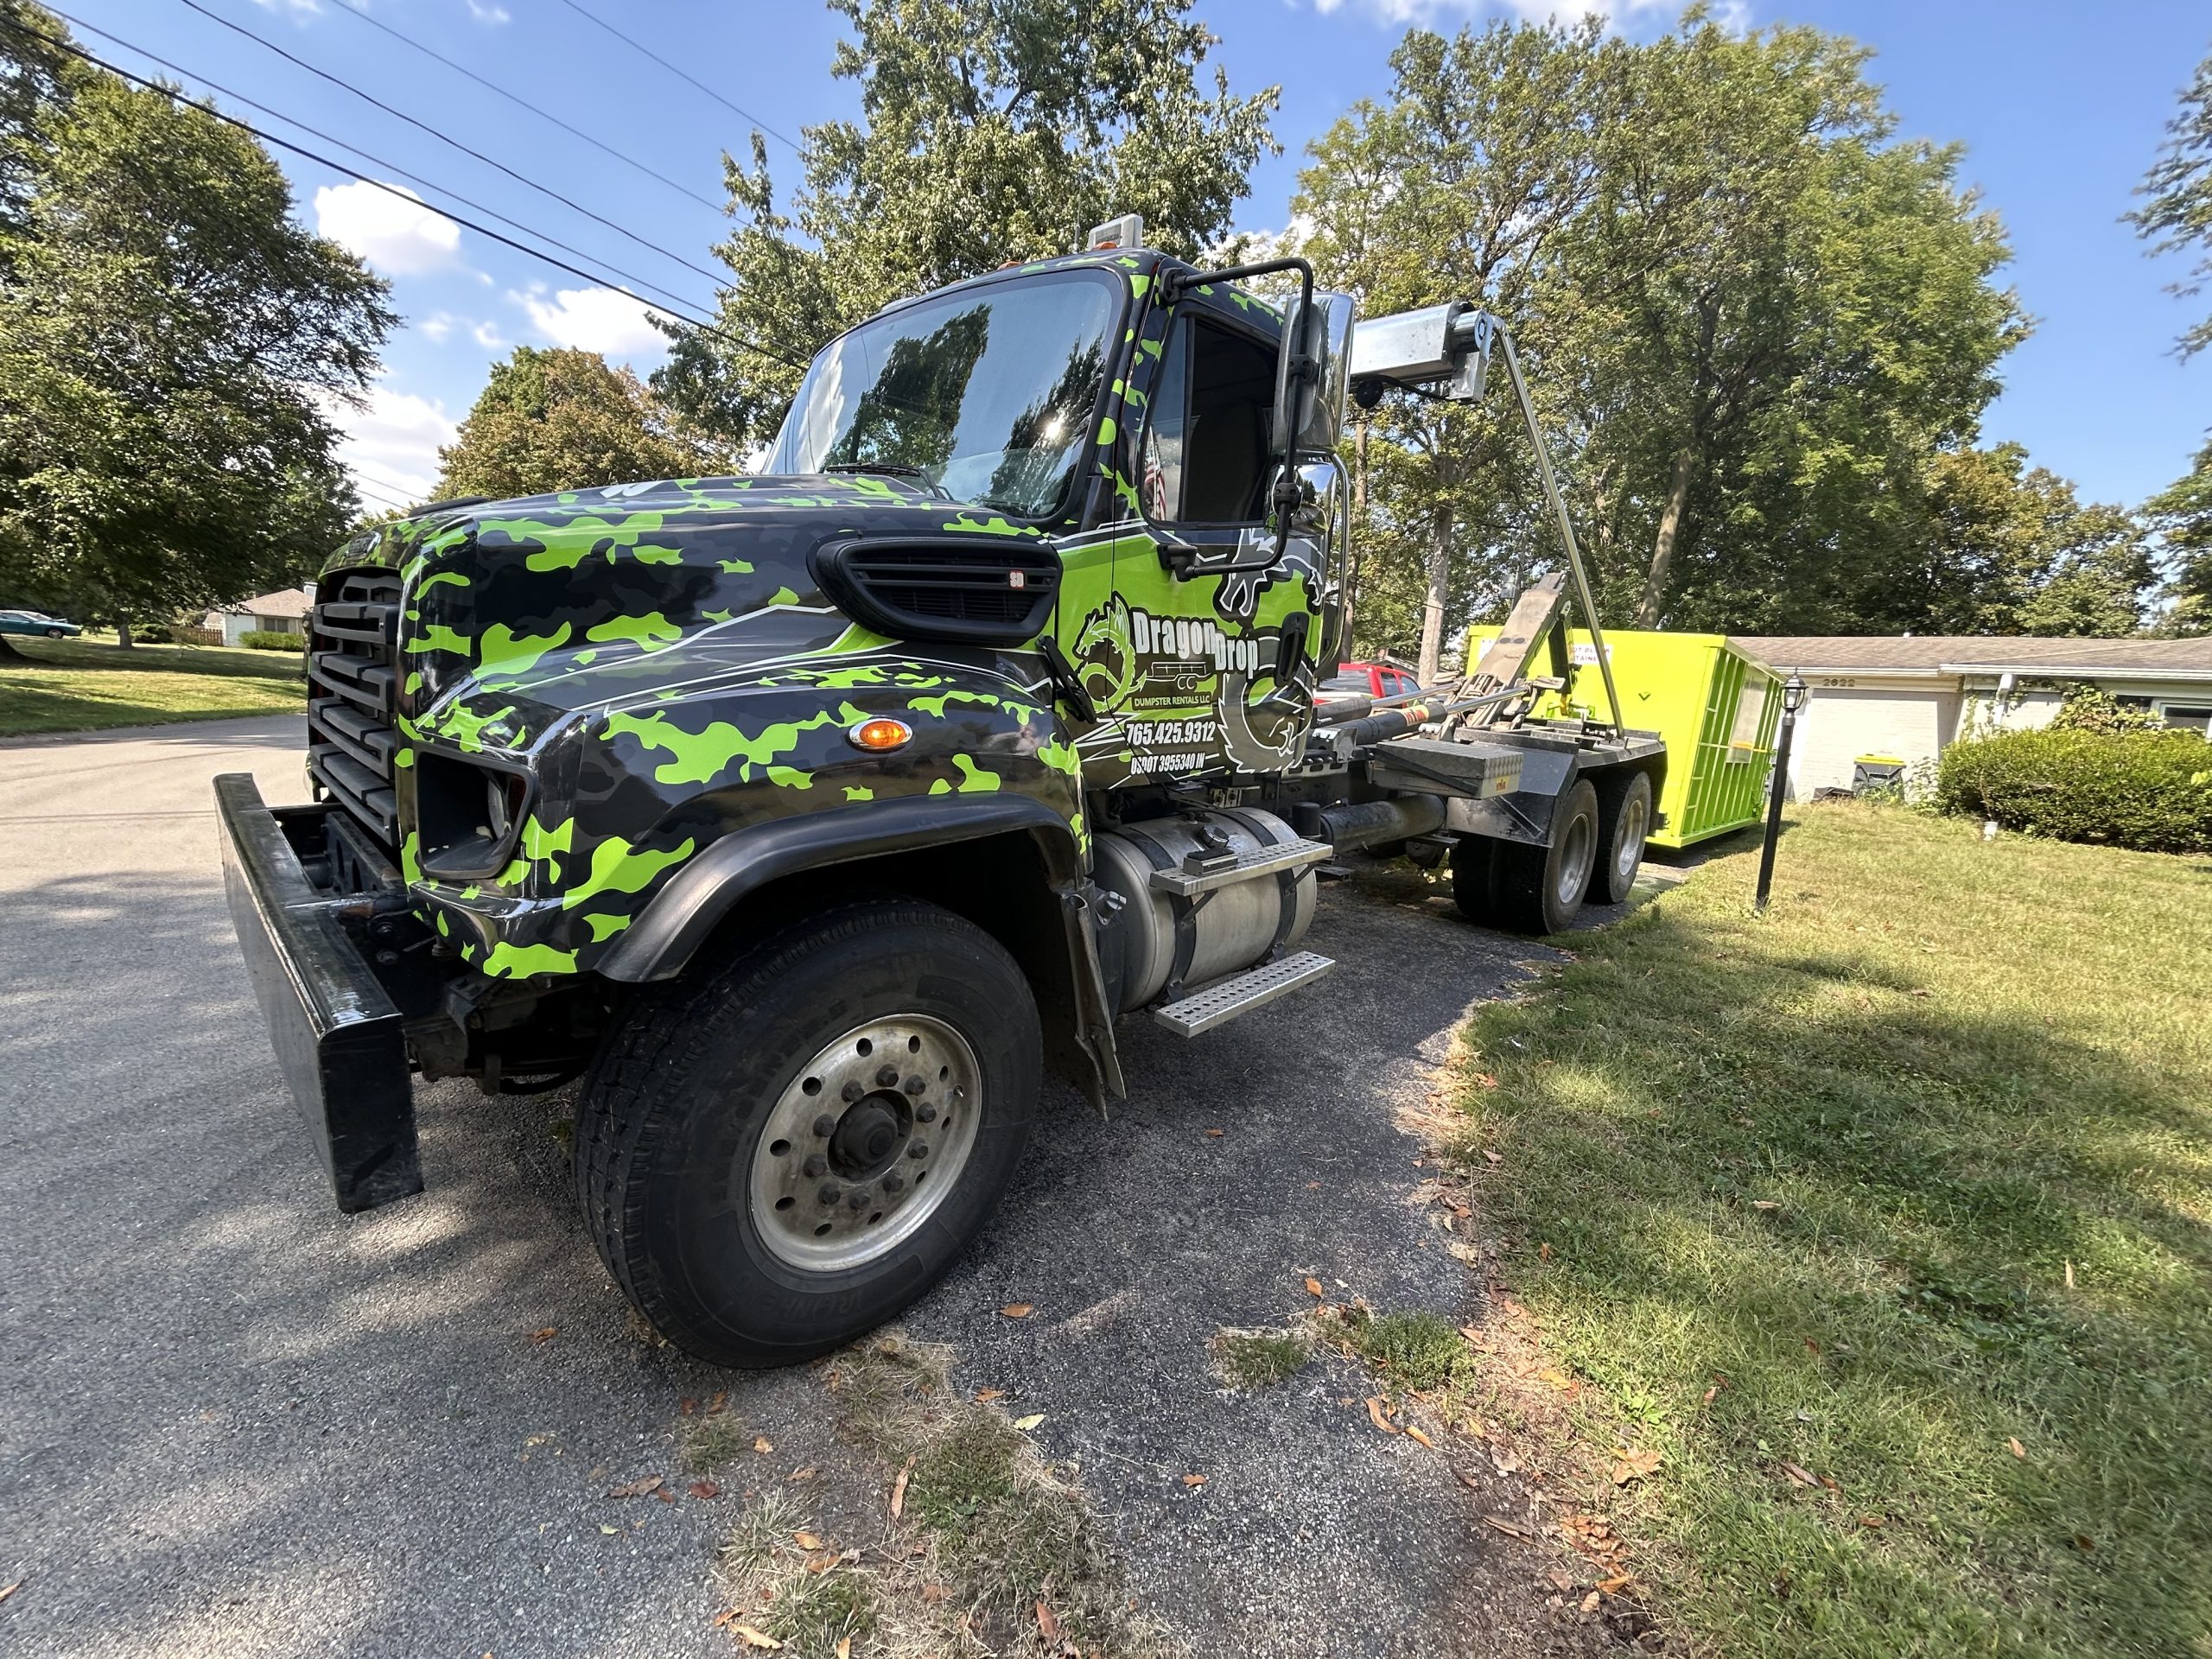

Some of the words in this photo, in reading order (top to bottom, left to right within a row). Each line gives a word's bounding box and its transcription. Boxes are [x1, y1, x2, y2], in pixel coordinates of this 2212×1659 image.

[1133, 611, 1216, 659] Dragon
[1215, 632, 1258, 680] Drop
[1822, 678, 1855, 687] 2622
[1134, 696, 1172, 707] DUMPSTER
[1172, 695, 1199, 705] RENTALS
[1199, 695, 1210, 703] LLC
[1126, 721, 1216, 746] 765.425.9312
[1130, 755, 1159, 775] USDOT
[1158, 753, 1196, 772] 3955340
[1195, 752, 1205, 769] IN
